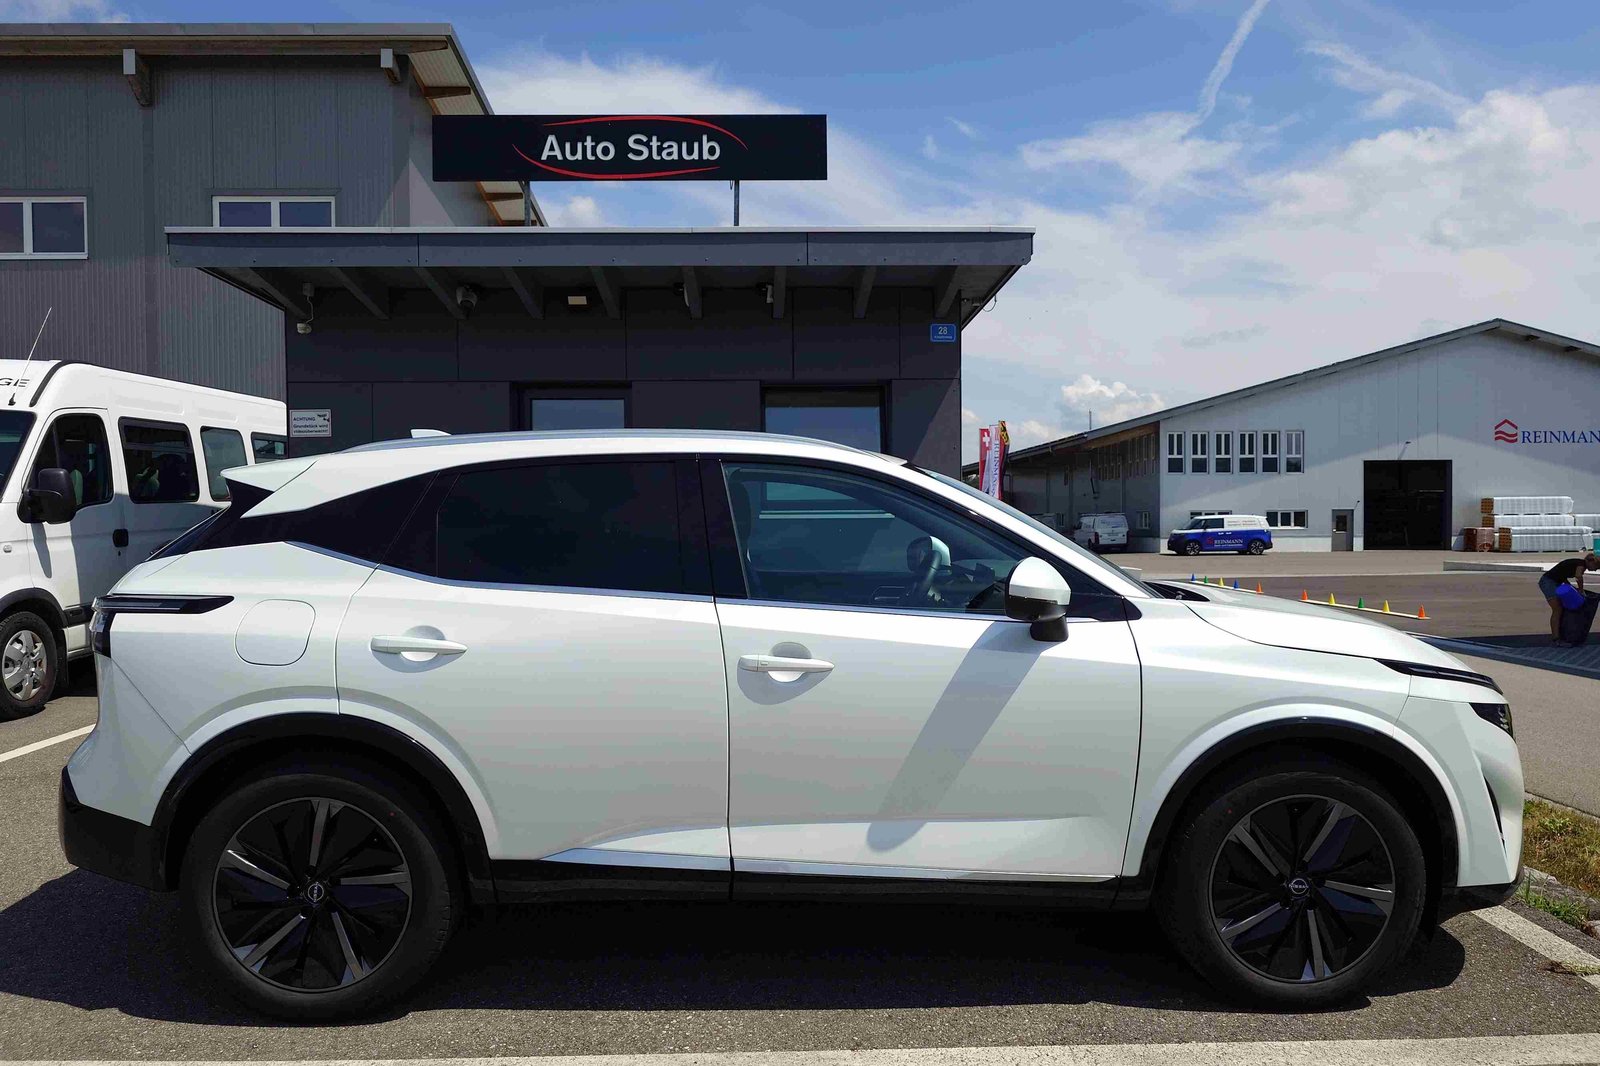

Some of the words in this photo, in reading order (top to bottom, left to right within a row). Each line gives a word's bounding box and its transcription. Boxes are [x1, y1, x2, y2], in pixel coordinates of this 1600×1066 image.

[541, 134, 616, 161] Auto
[627, 133, 721, 161] Staub
[938, 326, 948, 335] 28
